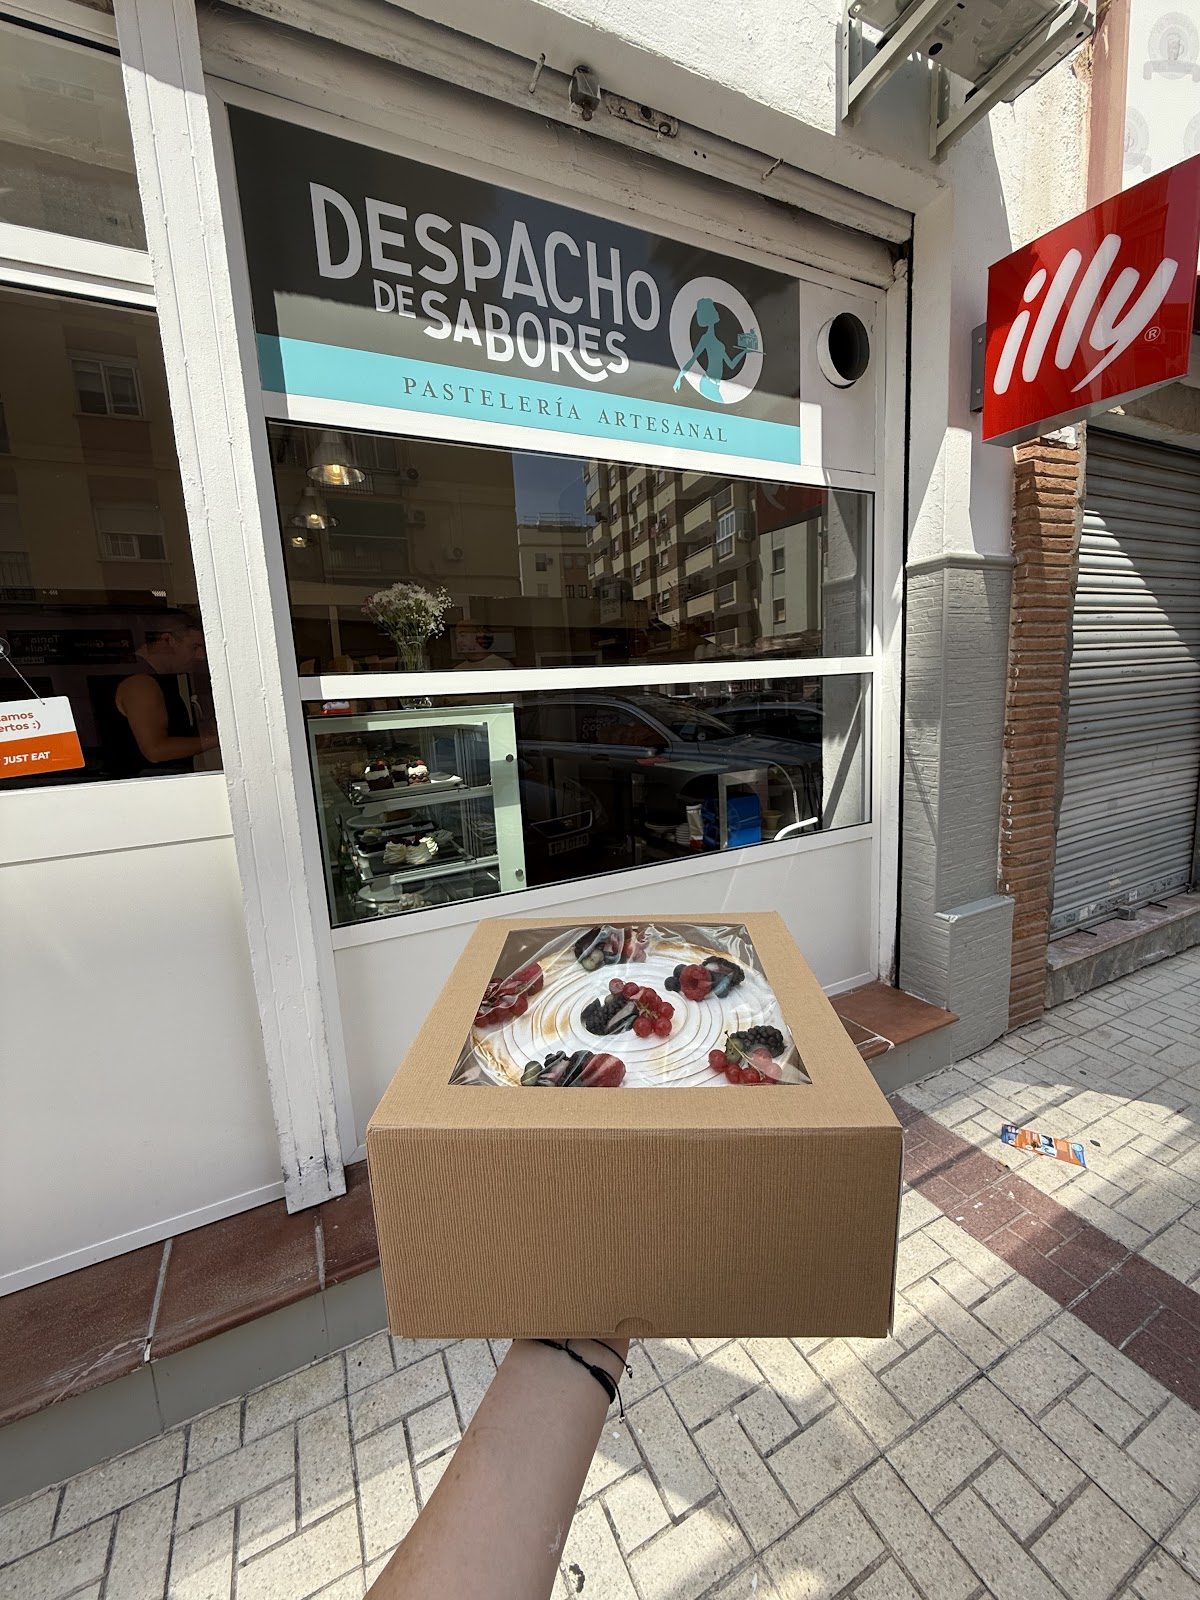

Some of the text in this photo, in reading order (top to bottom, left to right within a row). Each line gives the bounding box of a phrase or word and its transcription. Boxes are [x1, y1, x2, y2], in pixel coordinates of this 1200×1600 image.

[309, 181, 661, 332] DESPACHO
[373, 279, 630, 383] DE SABORES
[993, 233, 1179, 396] illy
[402, 375, 728, 443] PASTELERÍA ARTESANAL
[0, 712, 34, 722] amos
[3, 751, 51, 766] JUST EAT
